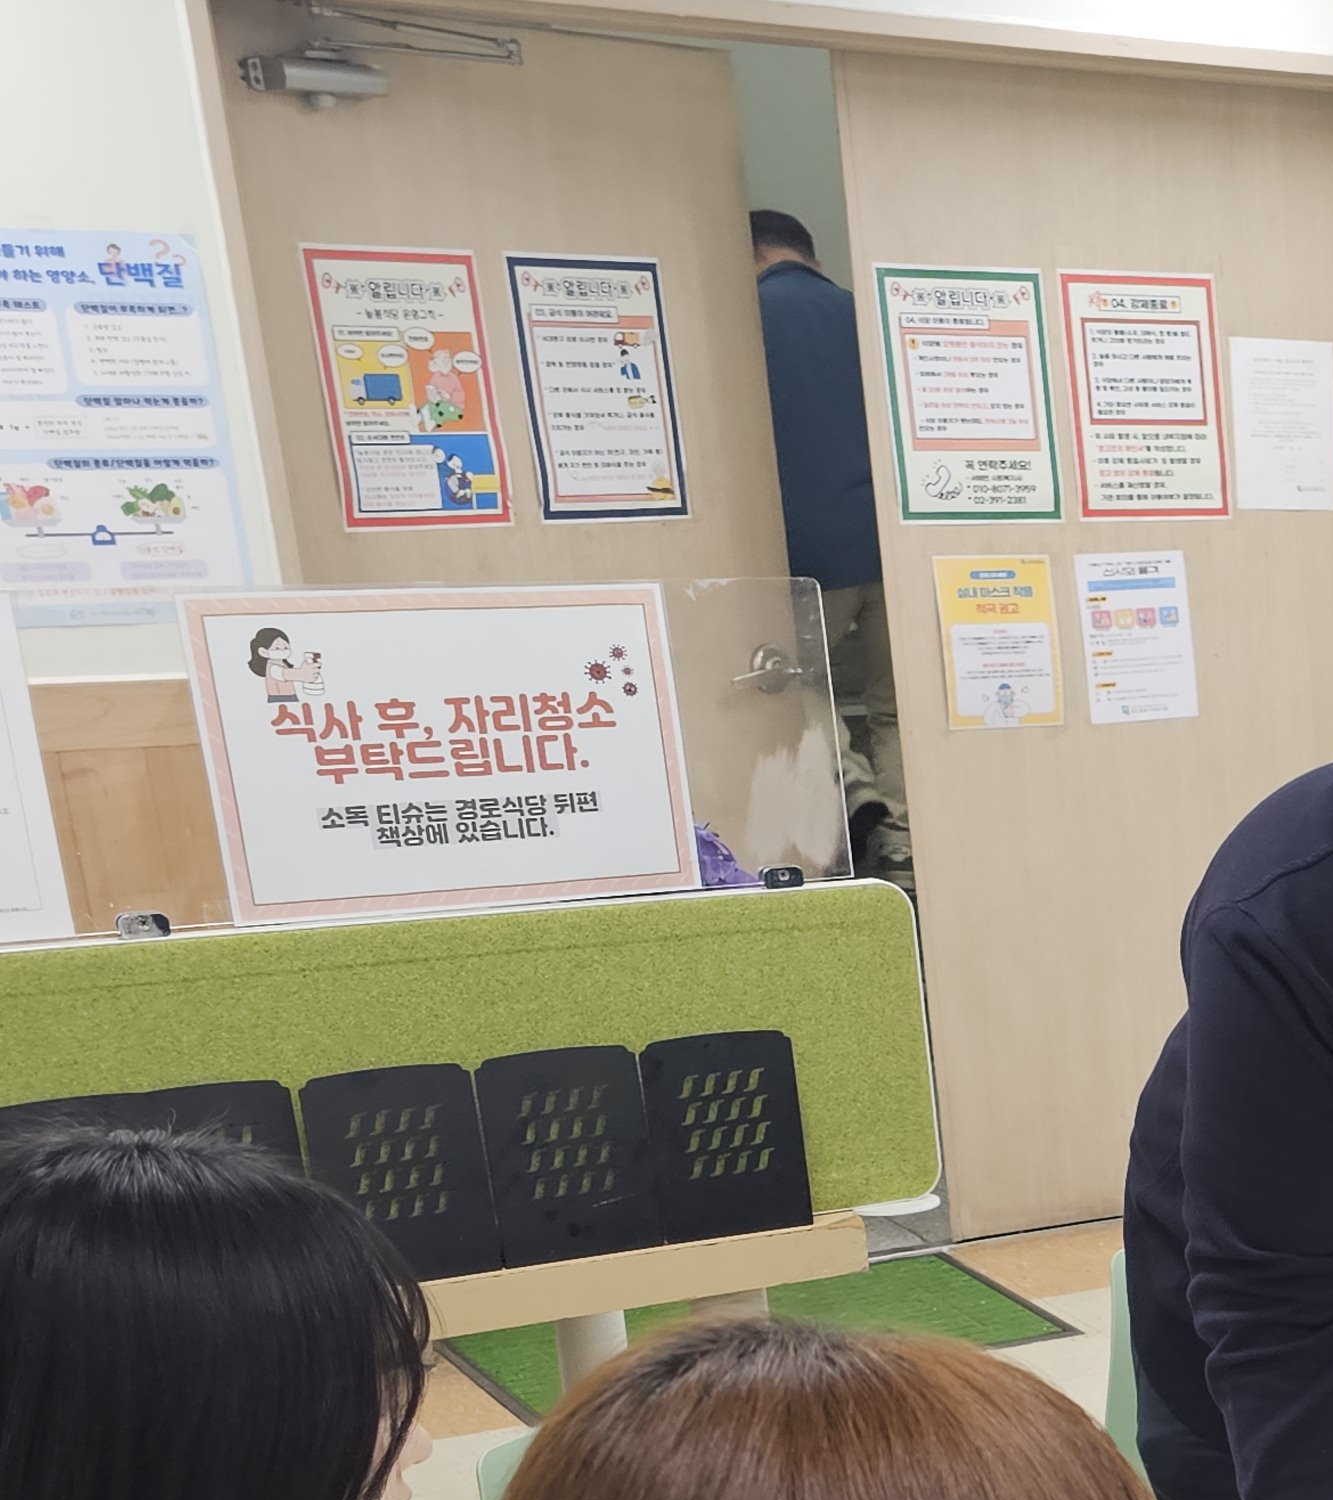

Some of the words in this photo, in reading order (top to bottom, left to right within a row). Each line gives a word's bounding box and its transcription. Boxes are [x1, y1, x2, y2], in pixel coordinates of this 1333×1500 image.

[34, 245, 66, 258] 위해
[12, 269, 43, 283] 하는
[97, 262, 185, 289] 단백질
[563, 280, 613, 297] 알립니다
[368, 281, 425, 299] 알립니다
[934, 290, 988, 307] 알립니다
[271, 701, 363, 743] 식사
[374, 698, 433, 740] 후,
[443, 692, 617, 735] 자리청소
[315, 733, 590, 785] 부탁드립니다.
[321, 806, 369, 829] 소독
[377, 801, 448, 826] 티슈는
[455, 796, 547, 820] 경로식당
[554, 791, 600, 814] 뒤편
[377, 822, 449, 847] 책상에
[456, 817, 555, 843] 있습니다.
